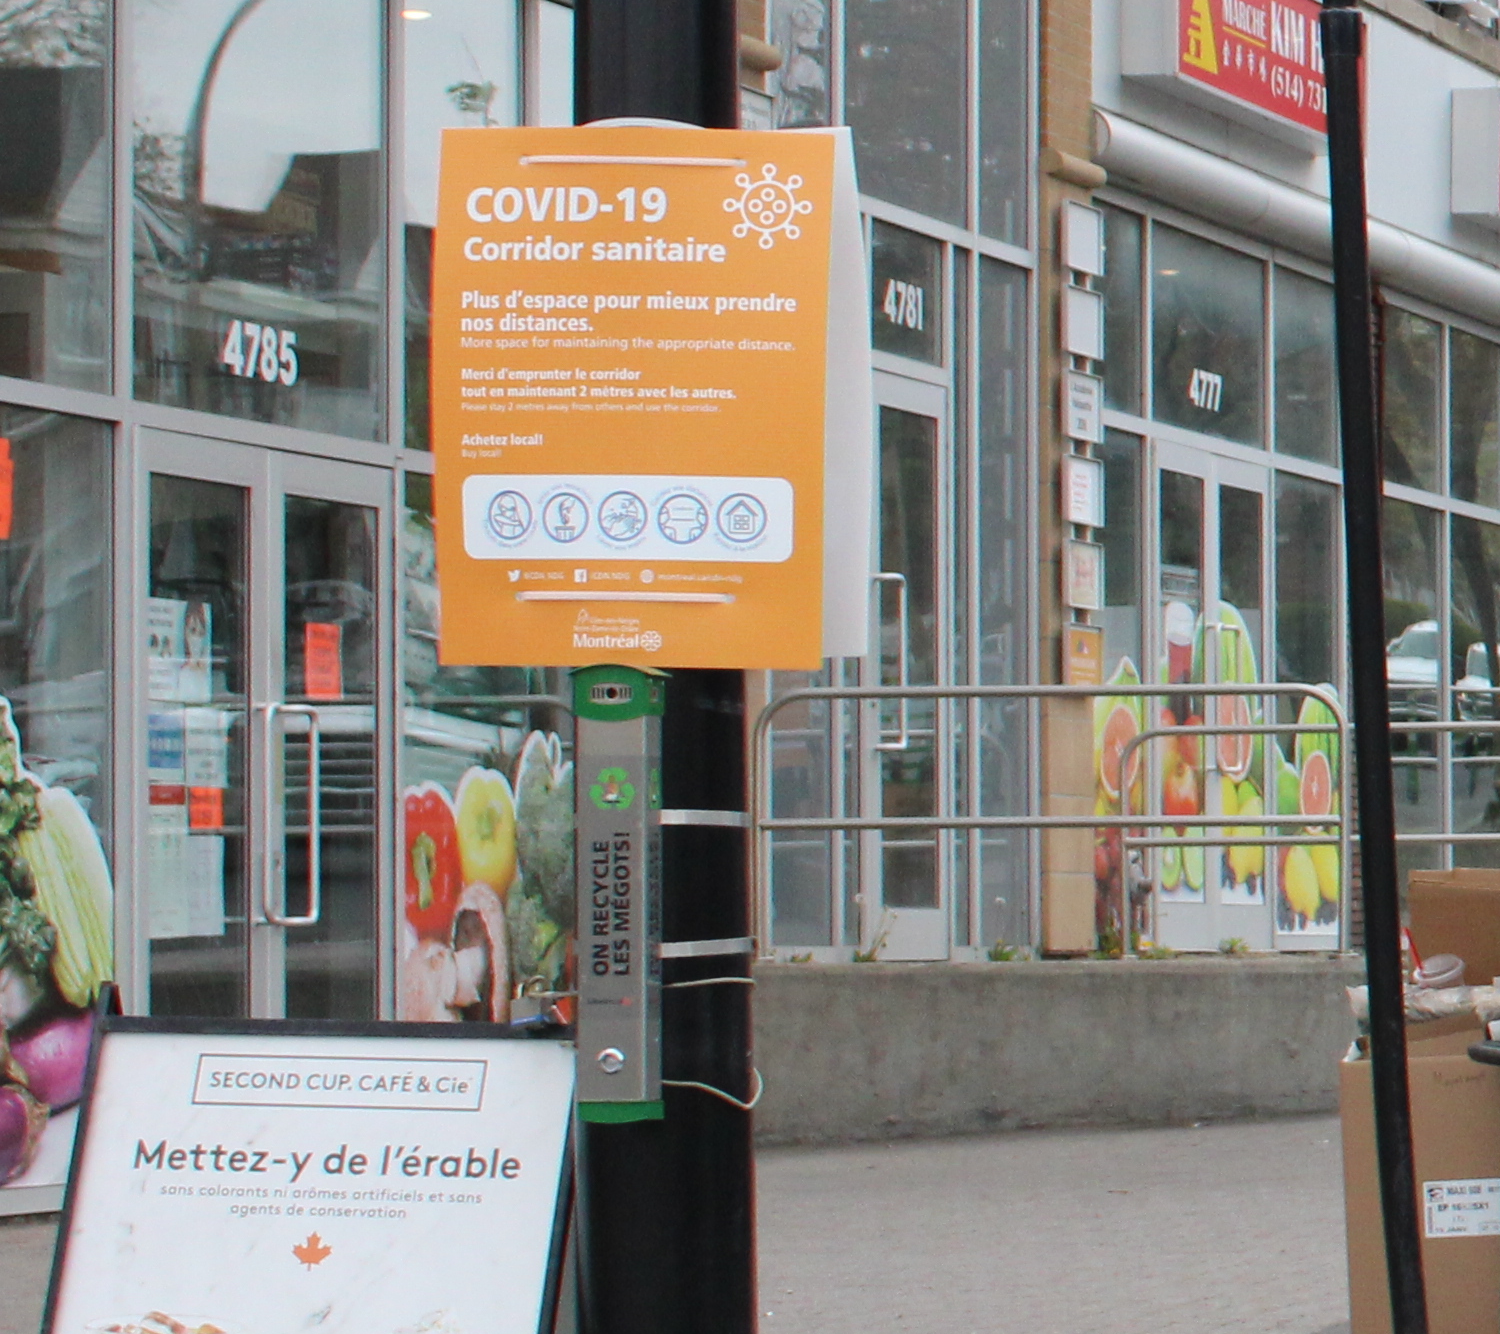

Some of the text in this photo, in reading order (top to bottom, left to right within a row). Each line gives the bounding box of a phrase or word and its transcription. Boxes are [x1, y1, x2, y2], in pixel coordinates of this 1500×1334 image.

[1270, 0, 1307, 67] KIM
[1270, 65, 1304, 108] (514)
[465, 186, 668, 223] COVID-19
[463, 235, 727, 263] Corridor sanitaire
[460, 289, 797, 316] Plus d’espace pour mieux prendre
[882, 277, 924, 331] 4781
[460, 312, 594, 332] nos distances.
[221, 318, 299, 388] 4785
[460, 335, 796, 353] More space for maintaining the appropriate distance.
[460, 368, 494, 381] Merci
[575, 368, 587, 381] le
[590, 368, 642, 382] corridor
[460, 384, 737, 401] tout en maintenant 2 mètres avec les autres.
[460, 402, 487, 413] Please
[488, 402, 506, 414] stay
[507, 402, 514, 412] 2
[461, 433, 544, 447] Achetez local!
[461, 449, 477, 460] Buy
[573, 632, 639, 650] Montréal
[592, 840, 610, 940] RECYCLE
[611, 830, 632, 977] LES MÉGOTS!
[592, 942, 610, 977] ON
[209, 1069, 302, 1091] SECOND
[357, 1070, 414, 1094] CAFÉ
[415, 1074, 431, 1094] &
[133, 1138, 313, 1183] Mettez-y
[322, 1143, 368, 1176] de
[160, 1184, 483, 1204] sans colorants ni arômes artificiels et sans
[229, 1202, 407, 1221] agents de conservation
